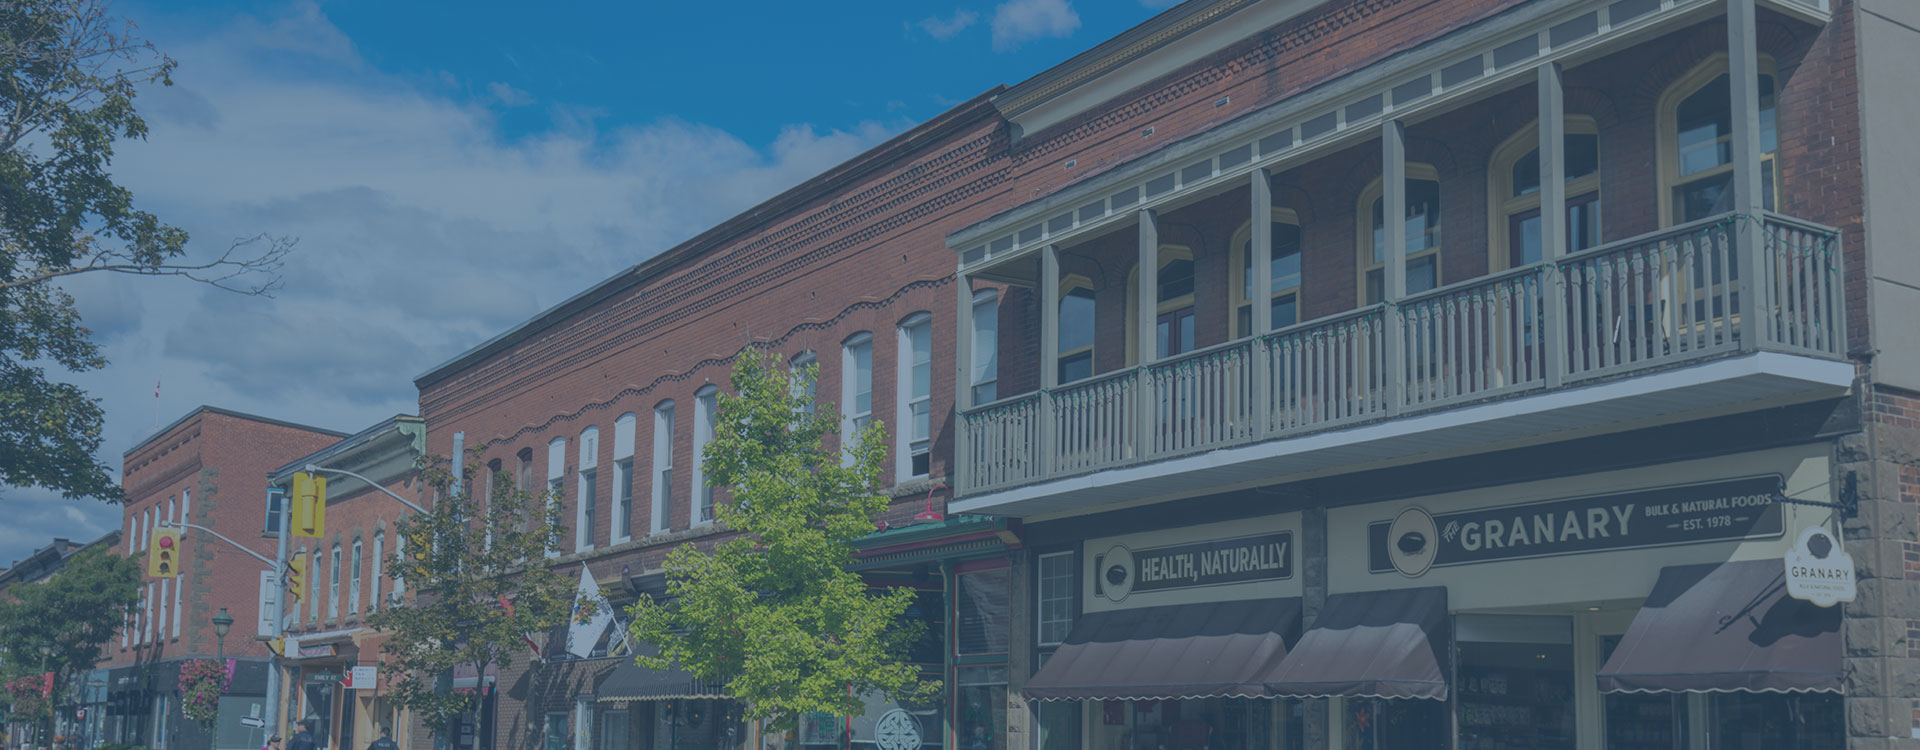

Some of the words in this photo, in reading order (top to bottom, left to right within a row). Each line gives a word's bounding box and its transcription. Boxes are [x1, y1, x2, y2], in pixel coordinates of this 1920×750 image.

[1645, 503, 1670, 517] BULK
[1671, 502, 1680, 515] &
[1682, 498, 1730, 514] NATURAL
[1731, 492, 1773, 509] FOODS
[1444, 522, 1461, 543] THE
[1460, 503, 1636, 552] GRANARY
[1683, 517, 1704, 531] EST.
[1707, 515, 1732, 528] 1978
[1141, 554, 1198, 583] HEALTH,
[1201, 542, 1288, 576] NATURALLY
[1791, 566, 1849, 581] GRANARY
